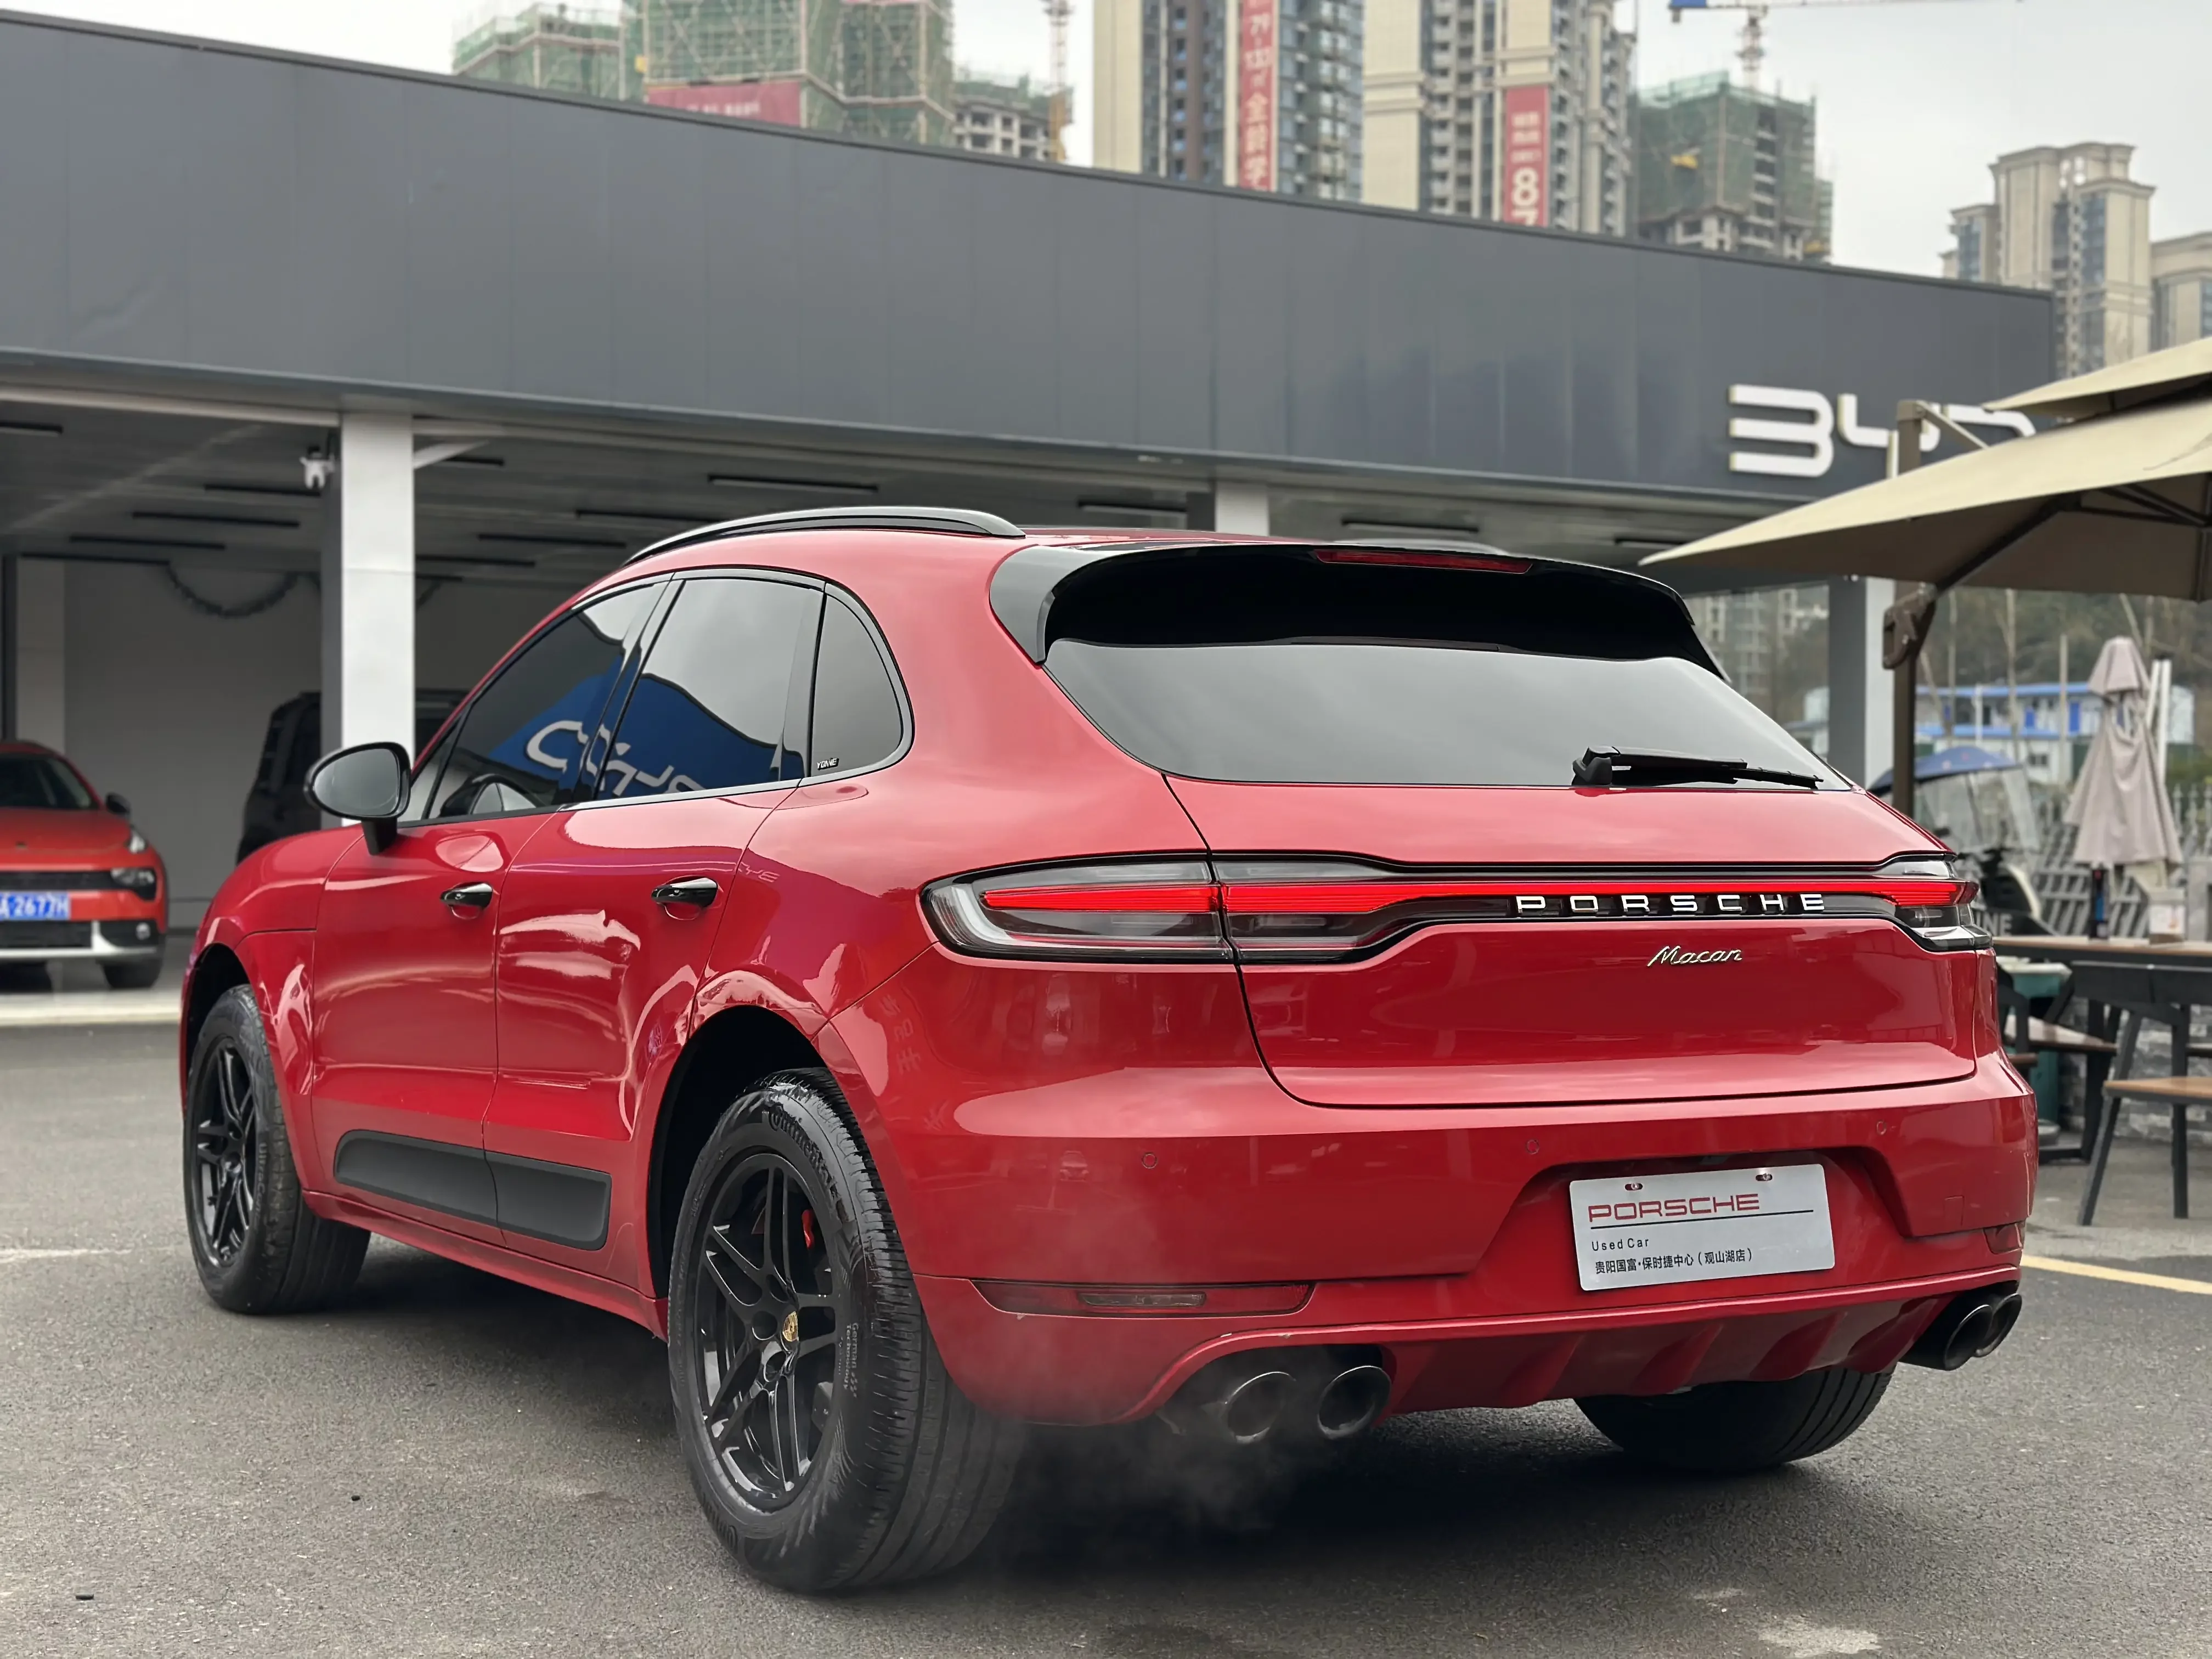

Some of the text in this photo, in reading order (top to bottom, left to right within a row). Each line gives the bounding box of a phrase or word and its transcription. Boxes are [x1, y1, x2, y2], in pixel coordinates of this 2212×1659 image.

[1516, 894, 1825, 913] PORSCHE
[1647, 945, 1742, 967] Macan
[1588, 1194, 1759, 1222] PORSCHE
[1592, 1238, 1649, 1251] Used Car
